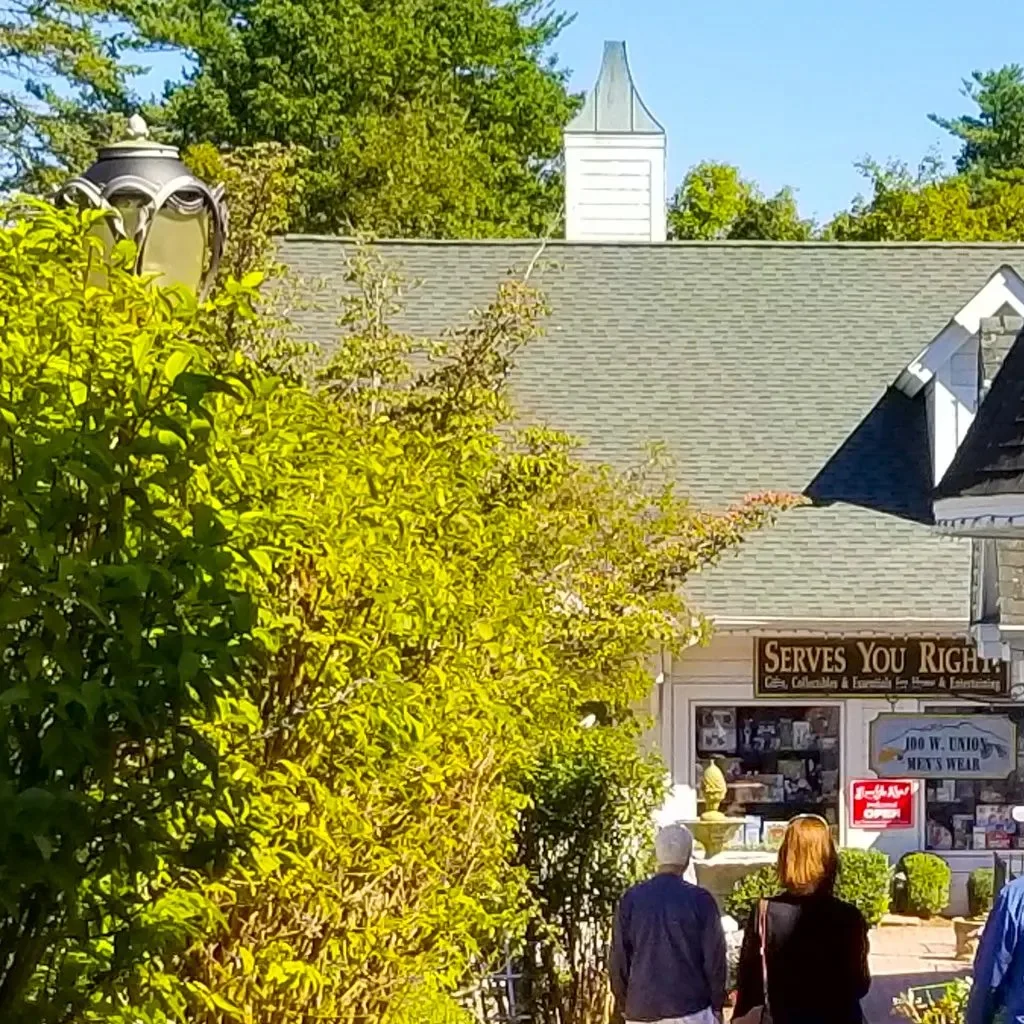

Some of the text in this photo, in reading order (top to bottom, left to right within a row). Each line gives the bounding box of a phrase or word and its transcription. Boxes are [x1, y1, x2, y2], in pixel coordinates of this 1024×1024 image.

[764, 640, 1000, 673] SERVES YOU RIGH
[905, 736, 988, 752] 100 W. UNION
[907, 757, 981, 772] MEN'S WEAR
